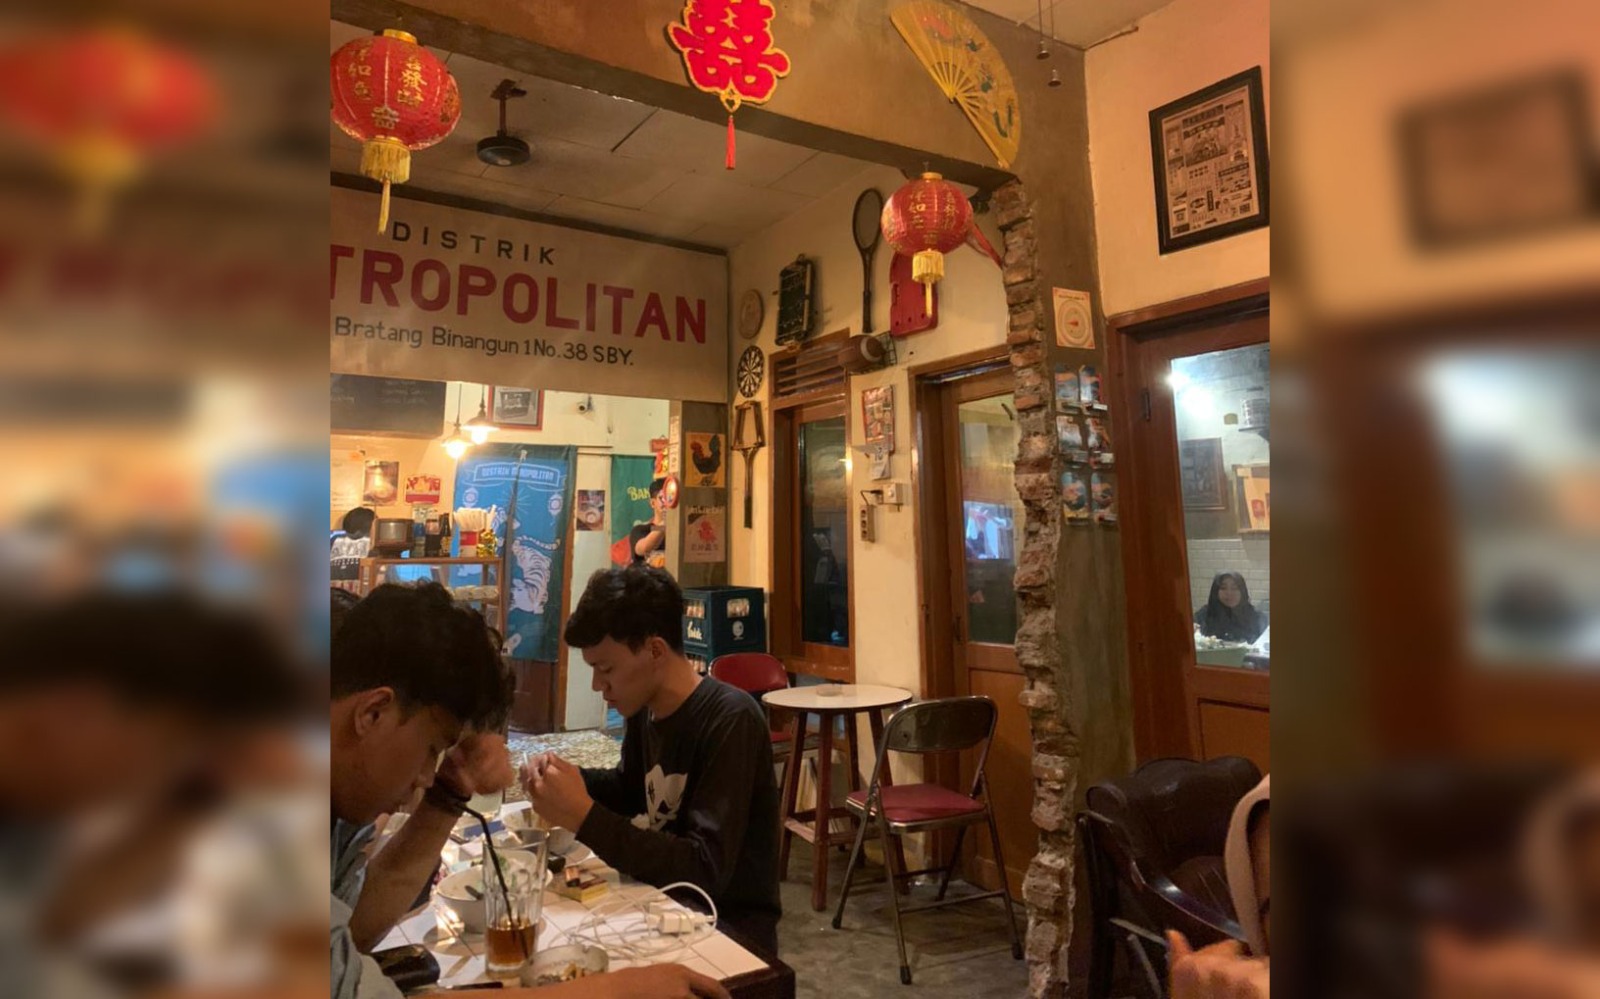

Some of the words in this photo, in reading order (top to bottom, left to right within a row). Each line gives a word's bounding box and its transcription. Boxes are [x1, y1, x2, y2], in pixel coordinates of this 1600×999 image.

[392, 221, 556, 266] DISTRIK
[335, 316, 422, 348] Bratang
[432, 326, 519, 356] Binangun
[593, 345, 634, 366] SBY.
